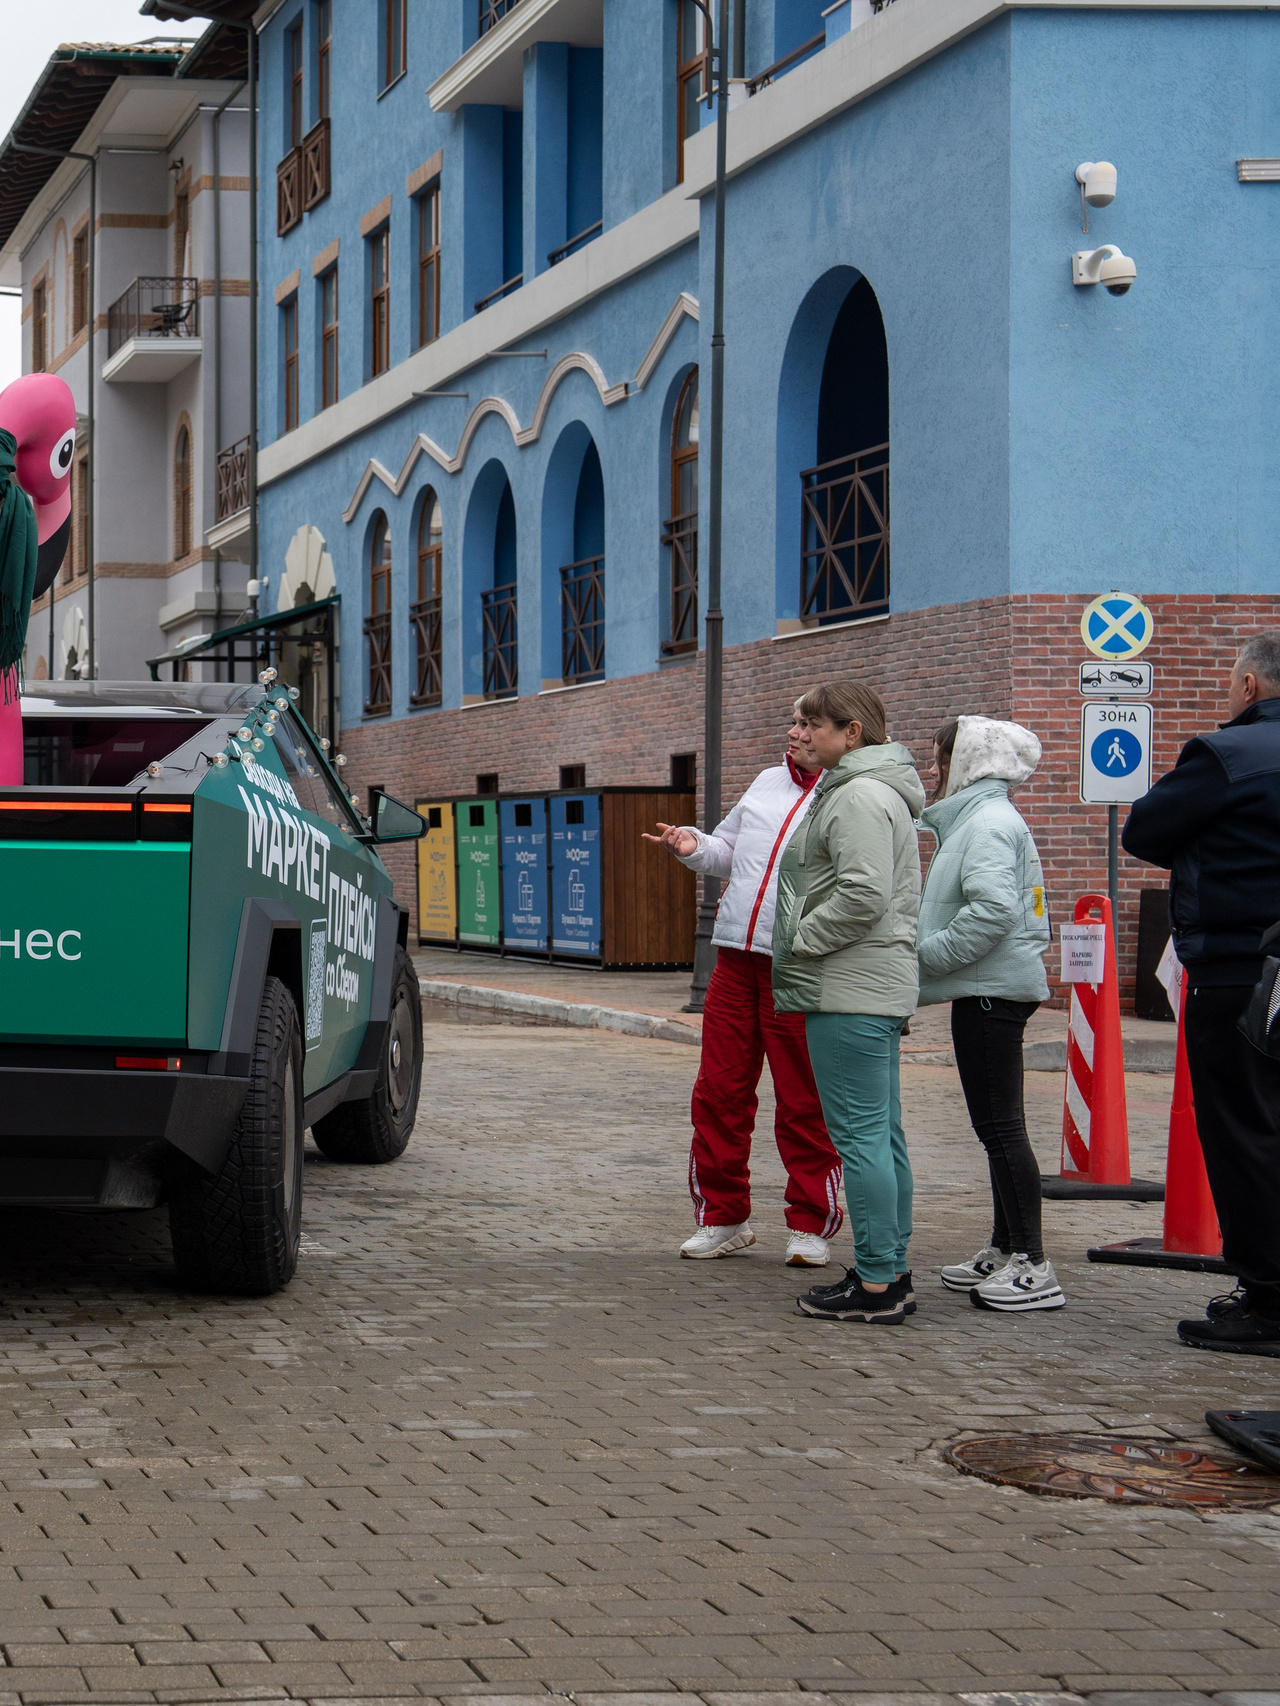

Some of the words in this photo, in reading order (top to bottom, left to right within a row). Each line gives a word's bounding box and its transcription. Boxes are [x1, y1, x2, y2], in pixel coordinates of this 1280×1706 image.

[1098, 710, 1138, 722] ЗОНА
[237, 784, 331, 904] МАРКЕТ
[327, 872, 377, 963] ПЛЕЙСЫ
[336, 953, 359, 1012] Сбером
